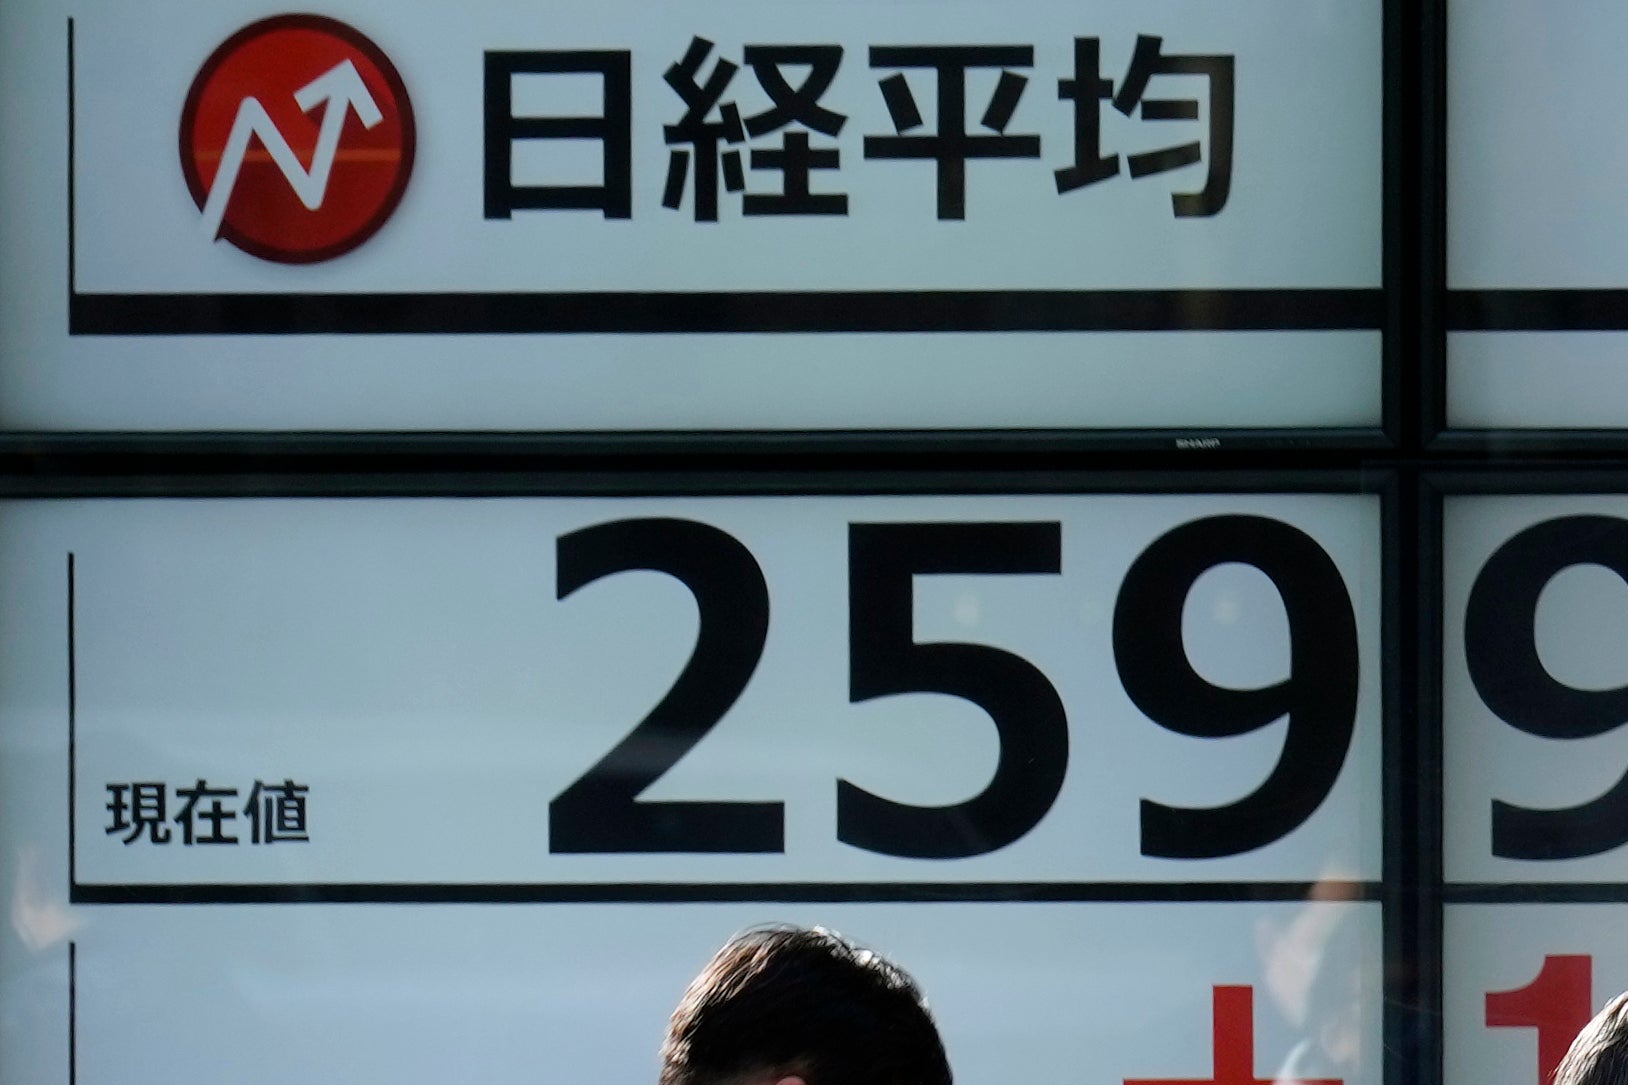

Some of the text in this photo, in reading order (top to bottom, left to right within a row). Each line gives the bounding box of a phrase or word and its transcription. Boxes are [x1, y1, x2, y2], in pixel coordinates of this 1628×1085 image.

[482, 33, 1236, 222] 日経平均
[104, 779, 311, 847] 現在値
